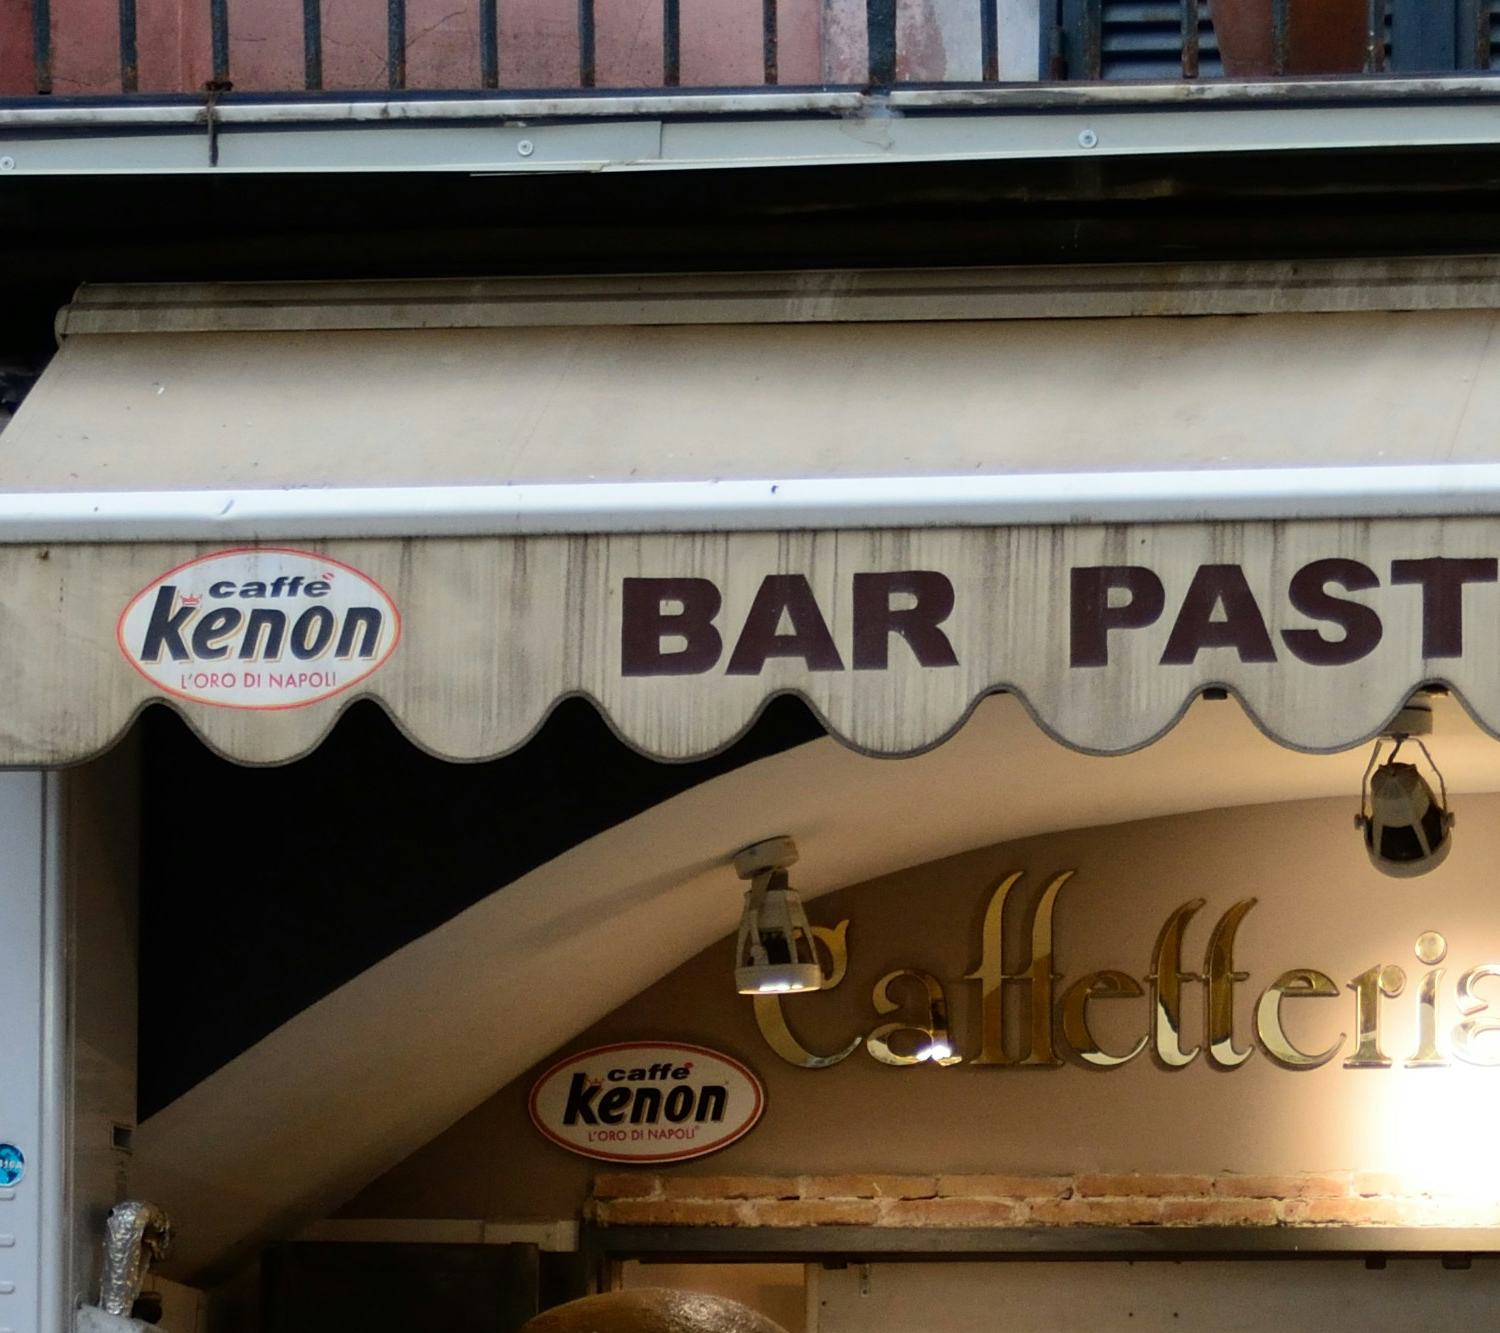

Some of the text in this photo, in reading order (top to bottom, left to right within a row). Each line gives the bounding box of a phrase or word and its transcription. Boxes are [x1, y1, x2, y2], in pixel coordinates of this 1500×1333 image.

[209, 571, 336, 602] caffè
[141, 585, 384, 665] kenon
[620, 570, 959, 678] BAR
[181, 670, 337, 691] L'ORO DI NAPOLI
[564, 1073, 729, 1126] kenon
[588, 1128, 696, 1142] L'ORO DI NAPOLI
